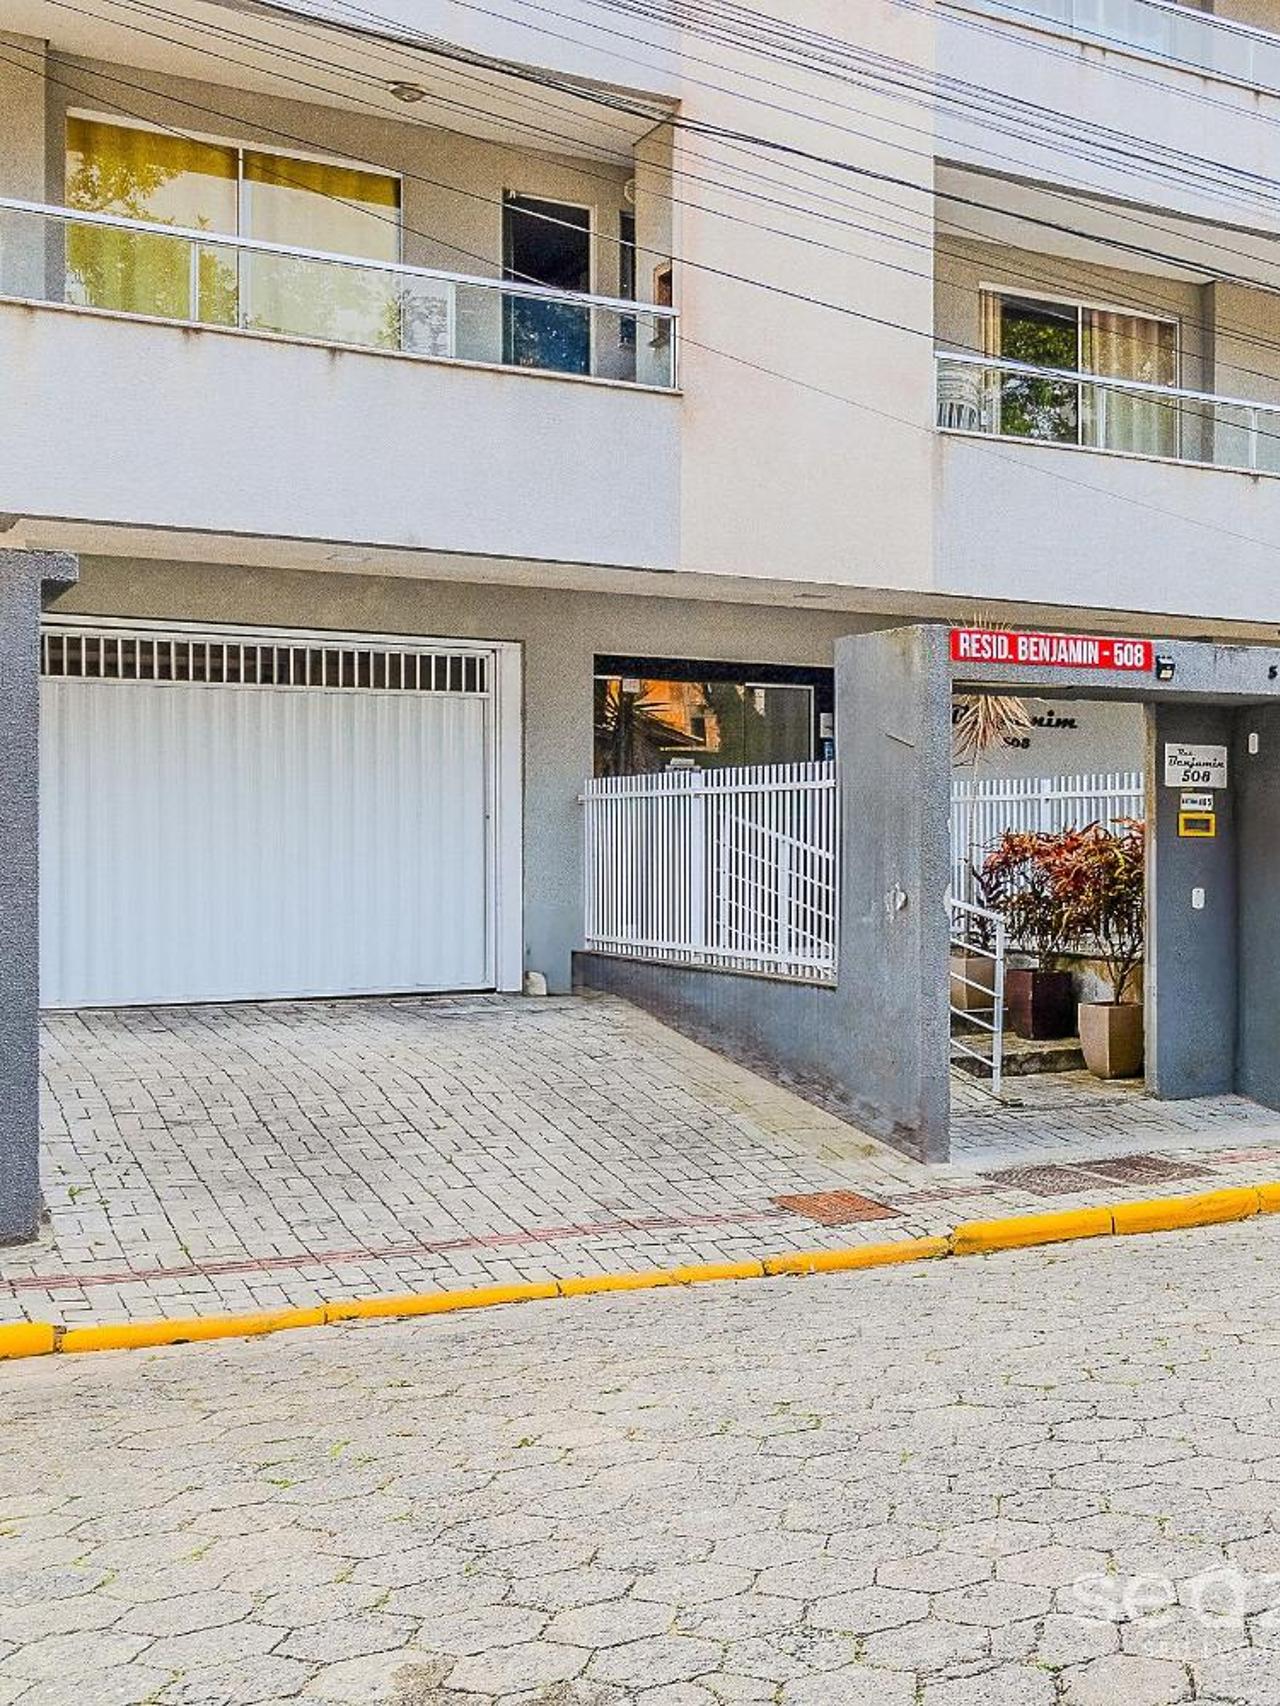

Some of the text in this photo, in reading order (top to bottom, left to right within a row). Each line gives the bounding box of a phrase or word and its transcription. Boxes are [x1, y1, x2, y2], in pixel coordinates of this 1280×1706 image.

[959, 632, 1014, 659] RESID.
[1017, 637, 1100, 665] BENJAMIN
[1113, 642, 1144, 667] 508
[1168, 755, 1225, 769] Benjamin
[1182, 769, 1211, 782] 508
